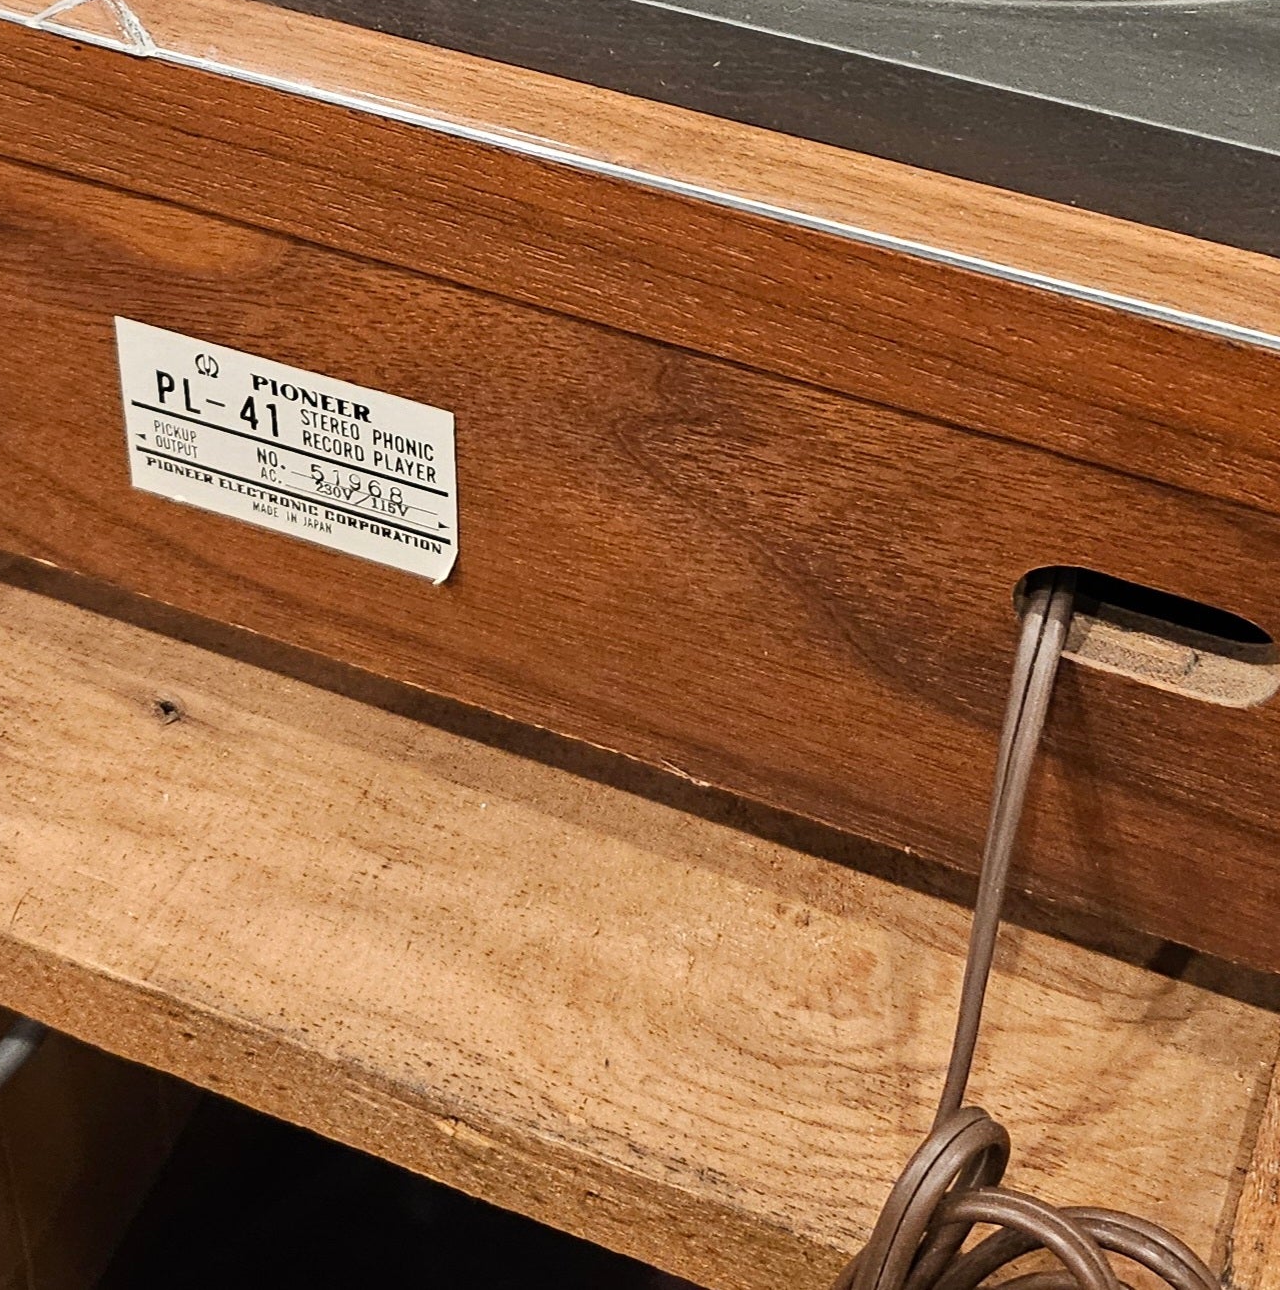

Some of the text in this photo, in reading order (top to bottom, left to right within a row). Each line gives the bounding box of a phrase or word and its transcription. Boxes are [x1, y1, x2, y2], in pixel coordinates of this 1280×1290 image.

[155, 369, 279, 437] PL-41
[250, 373, 372, 423] PIONEER
[154, 420, 197, 443] PICKUP
[155, 436, 199, 458] OUTPUT
[301, 409, 434, 462] STEREO PHONIC
[257, 447, 286, 470] NO.
[303, 430, 436, 484] RECORD PLAYER
[146, 456, 442, 555] PIONEER ELECTRONIC CORPORATION
[252, 501, 333, 535] MADE IN JAPAN
